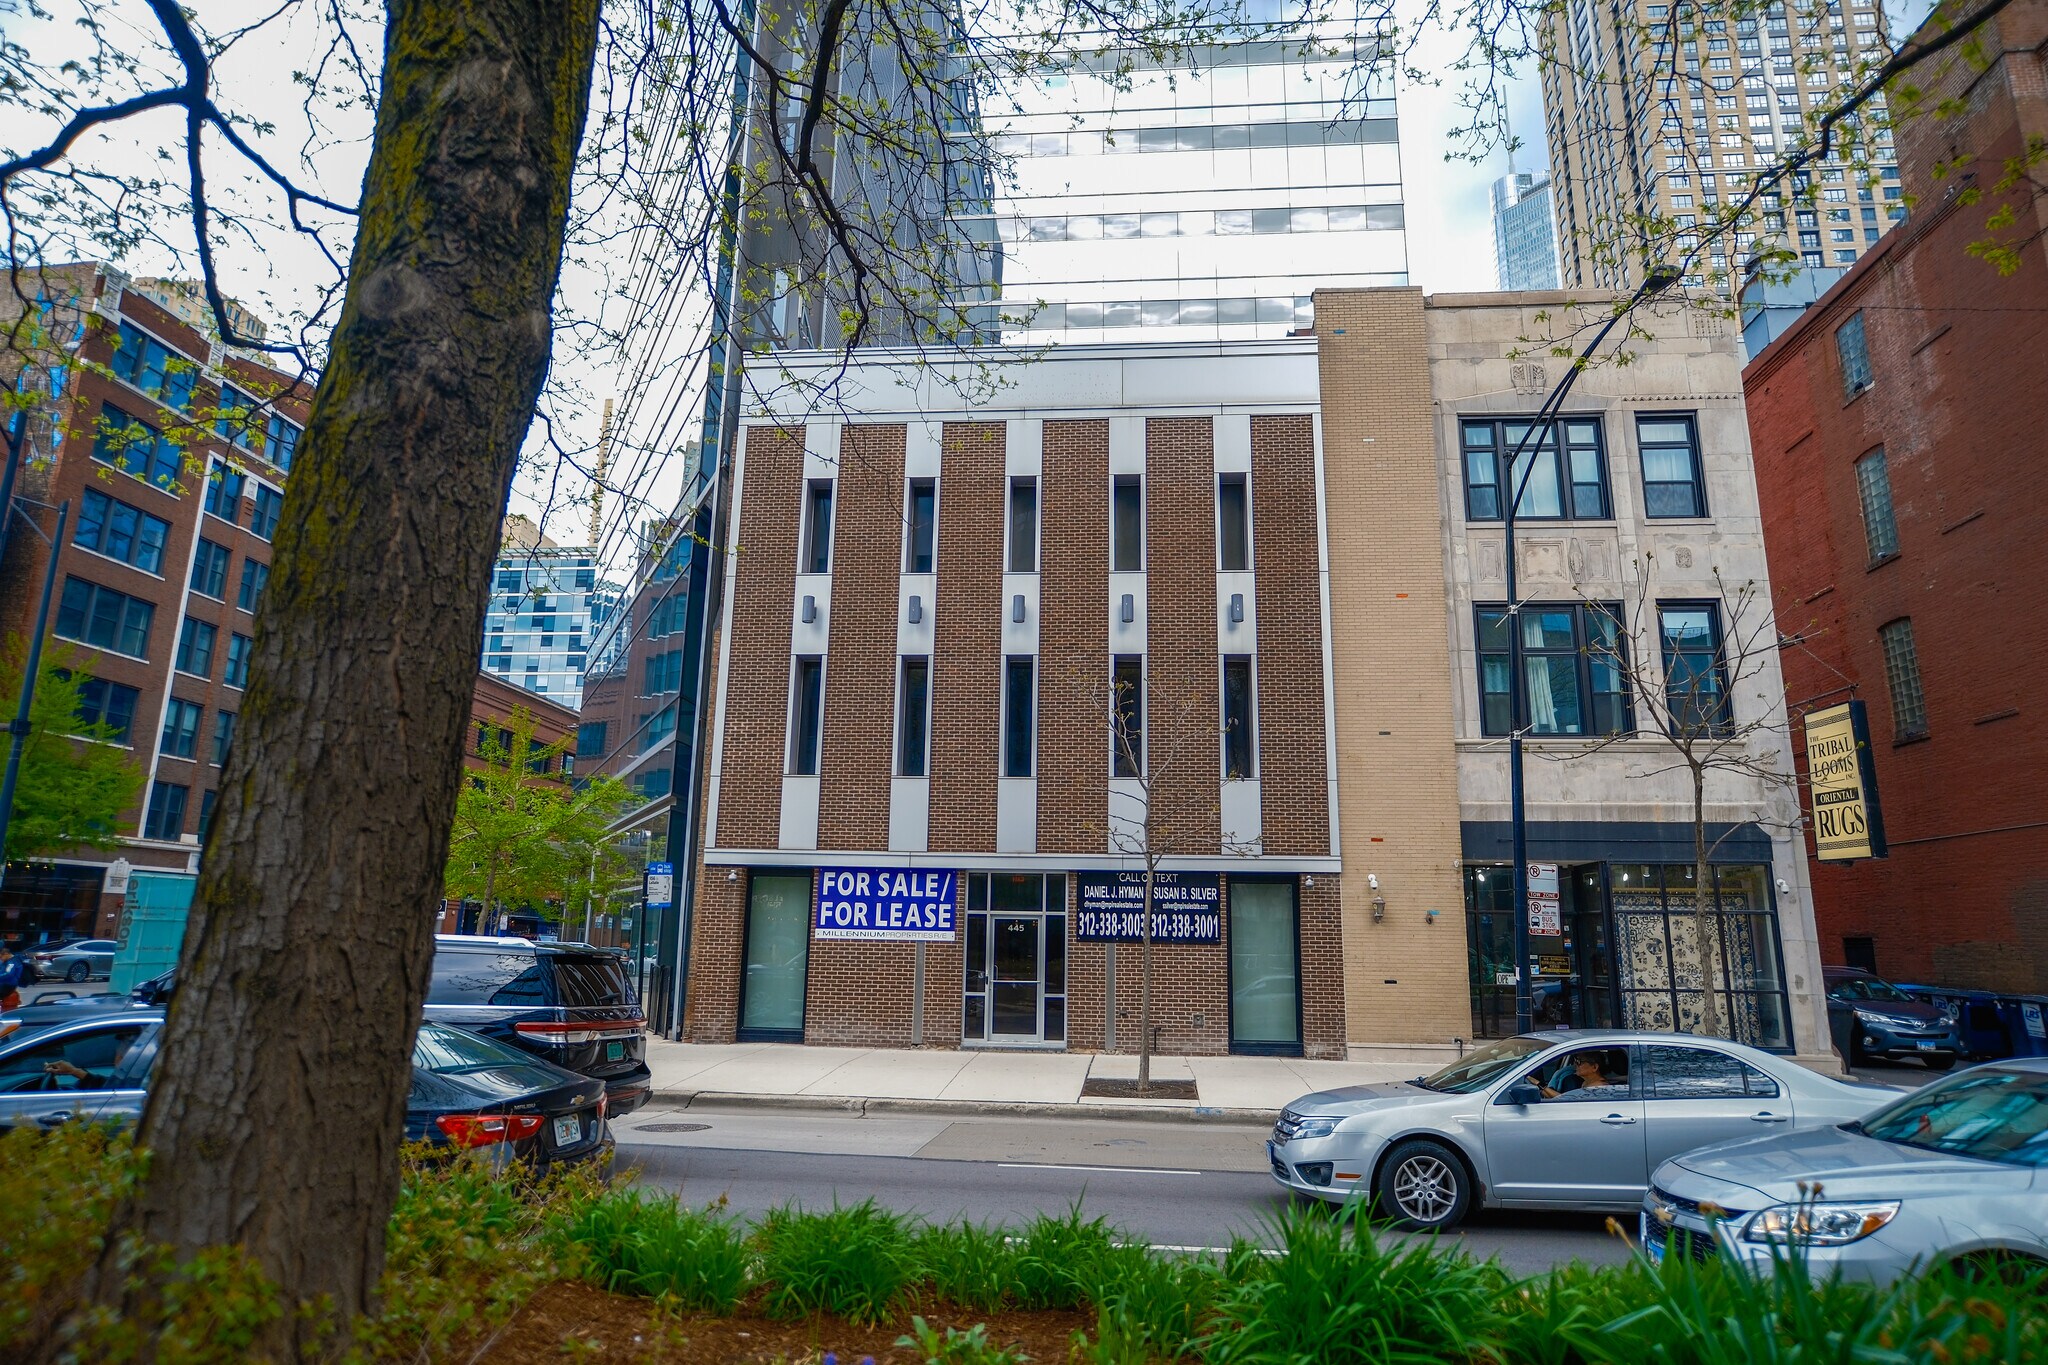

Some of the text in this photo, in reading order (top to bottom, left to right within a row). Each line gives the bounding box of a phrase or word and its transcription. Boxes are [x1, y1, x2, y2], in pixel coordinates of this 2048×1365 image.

[1809, 735, 1819, 743] THE
[1809, 736, 1853, 759] TRIBAL
[1813, 756, 1854, 778] LOOMS
[1845, 773, 1856, 781] INC.
[1819, 789, 1855, 803] ORIENTAL
[1817, 804, 1865, 838] RUGS
[1118, 872, 1179, 883] CALL O TEXT
[822, 872, 951, 902] FOR SALE/
[1084, 885, 1144, 899] DANIEL J. HYMAN
[1153, 886, 1218, 900] SUSAN B. SILVER
[116, 879, 141, 951] erikson
[820, 902, 952, 928] FOR LEASE
[1007, 924, 1025, 932] 445
[1151, 913, 1219, 938] 312-338-3001
[1934, 1001, 1948, 1010] LRS
[2025, 1010, 2040, 1020] LRS
